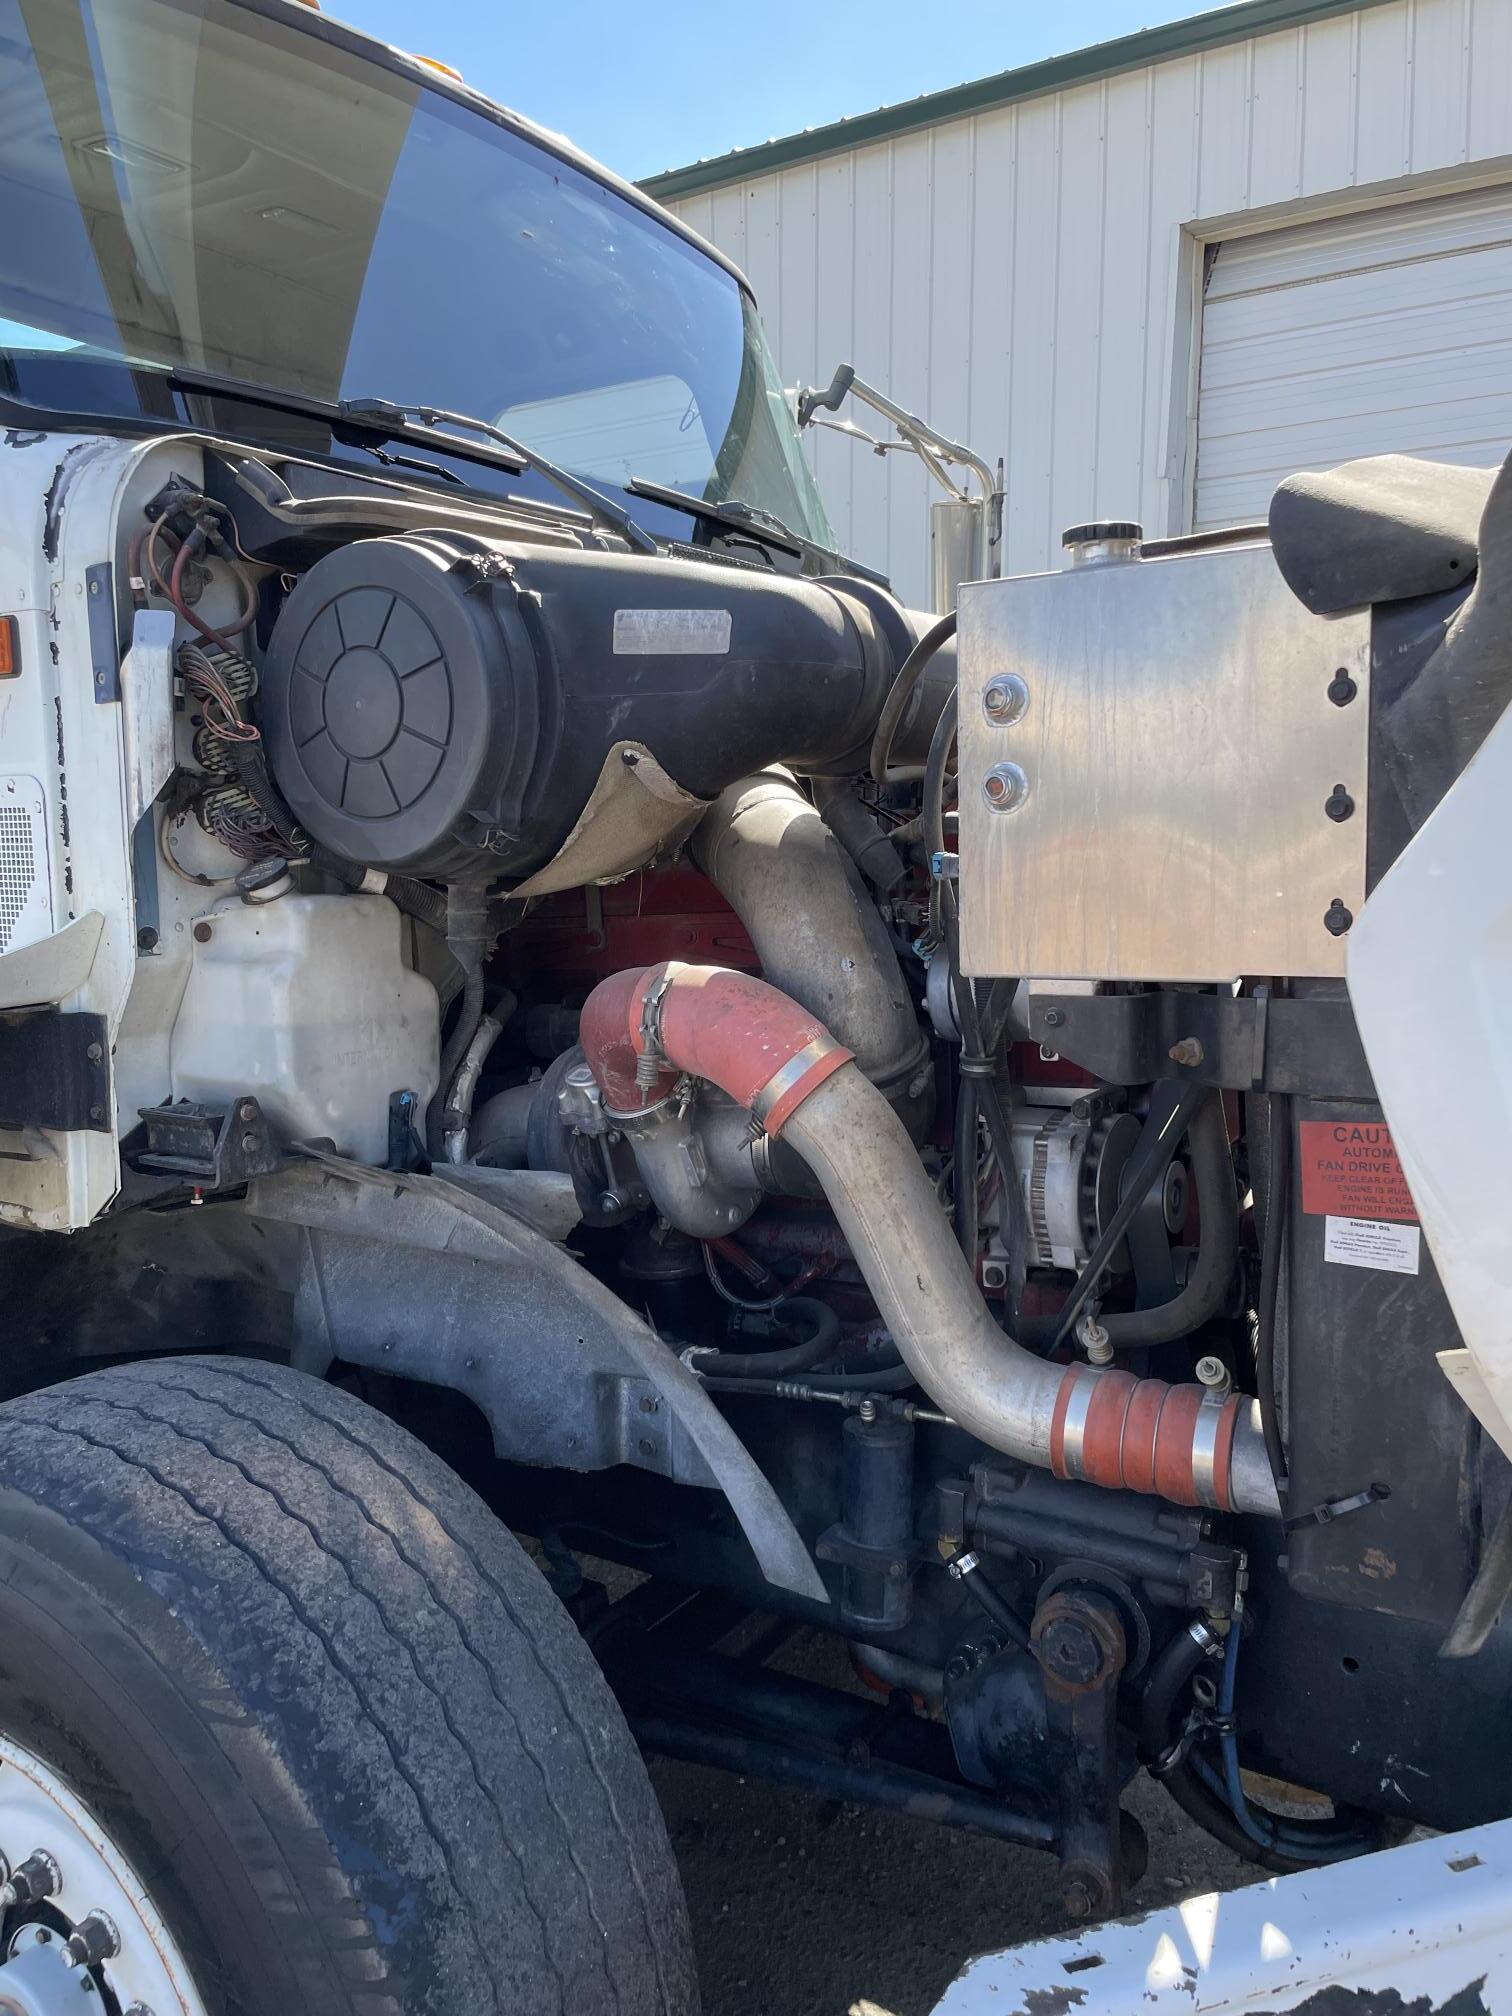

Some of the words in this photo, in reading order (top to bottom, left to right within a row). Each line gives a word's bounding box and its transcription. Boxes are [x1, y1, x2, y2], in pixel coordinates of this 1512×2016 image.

[1344, 1147, 1395, 1158] AUTOM
[1317, 1160, 1344, 1171] FAN
[1349, 1161, 1390, 1174] DRIVE
[1322, 1175, 1346, 1183] KEEP
[1349, 1175, 1381, 1184] CLEAR
[1383, 1177, 1396, 1185] OF
[1337, 1184, 1373, 1192] ENGINE
[1387, 1187, 1411, 1195] RUN
[1364, 1196, 1386, 1204] WILL
[1339, 1204, 1383, 1213] WITHOUT
[1350, 1221, 1377, 1230] ENGINE
